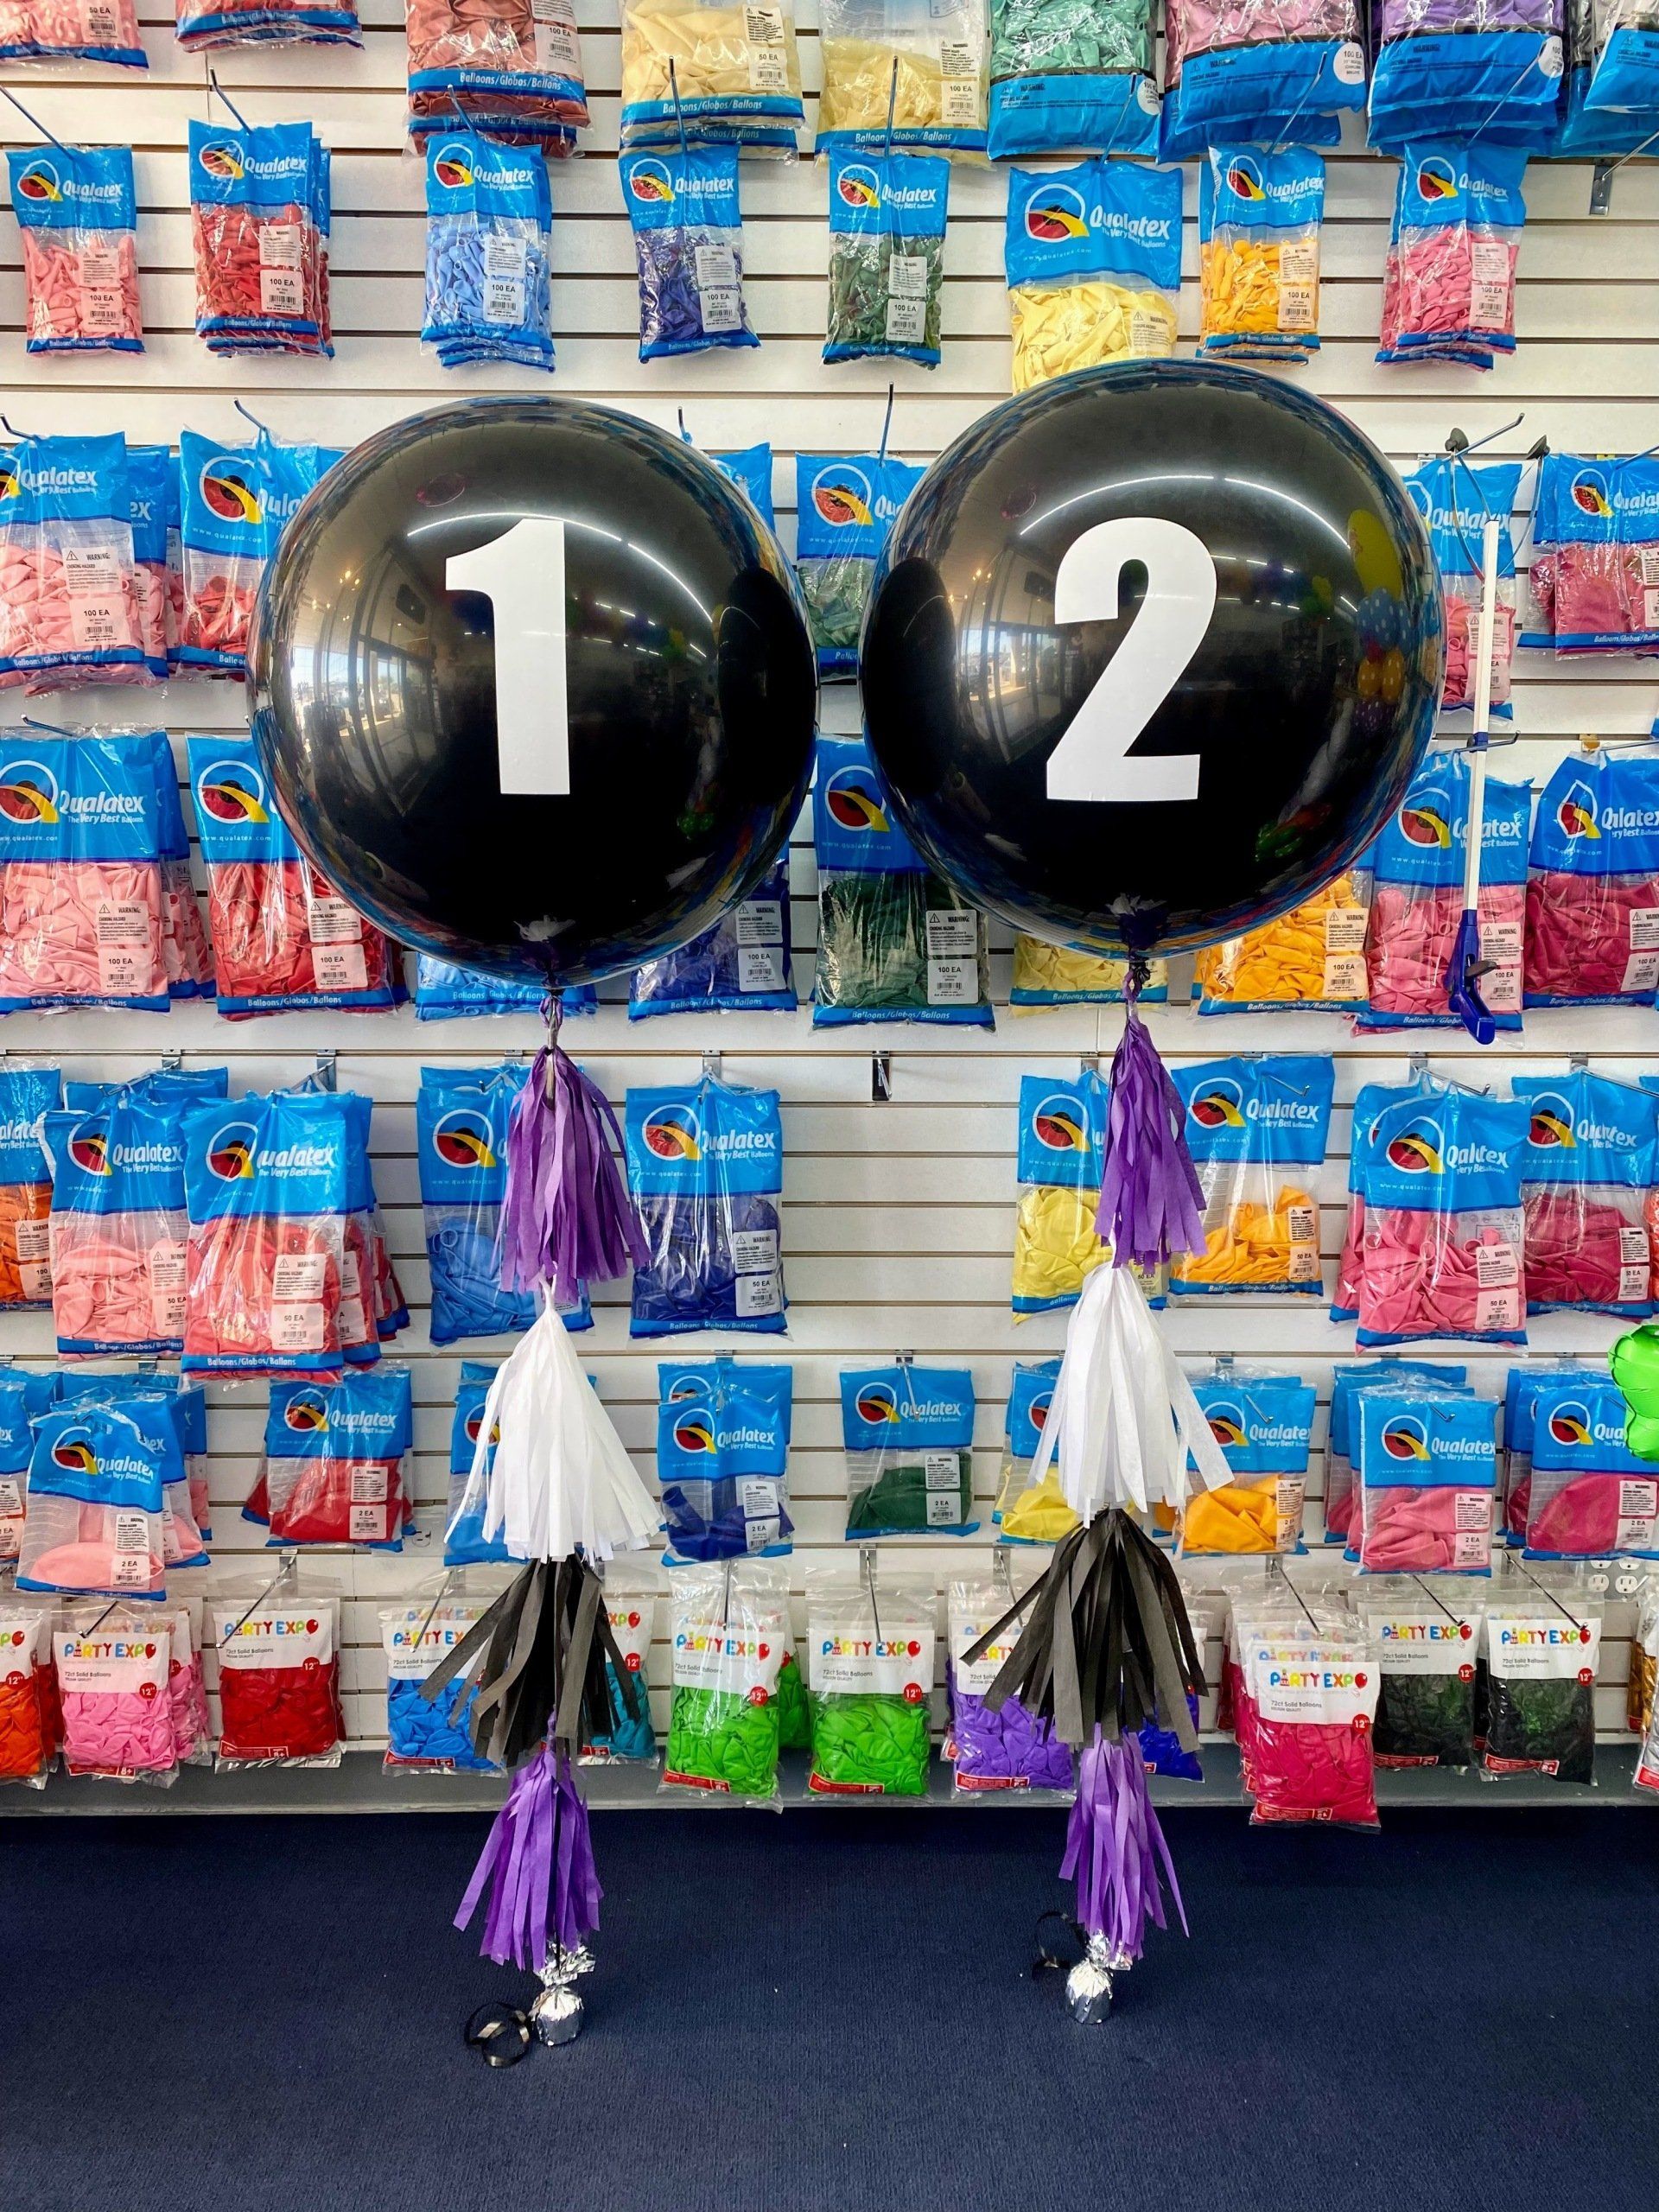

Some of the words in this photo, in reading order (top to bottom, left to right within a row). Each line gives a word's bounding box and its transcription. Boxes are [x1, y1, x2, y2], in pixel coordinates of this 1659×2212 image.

[549, 27, 560, 35] 100
[561, 29, 572, 37] EA
[759, 53, 767, 61] 50
[769, 53, 779, 61] EA
[1343, 50, 1354, 59] 100
[460, 73, 562, 91] Balloons/Globos/Ballons
[663, 99, 762, 112] Baloons/Globos/Ballons
[855, 130, 951, 143] Balloon/Globos/Ballons
[245, 156, 307, 173] Qualatex
[473, 166, 534, 184] Qualatex
[63, 181, 123, 198] Qualatex
[881, 184, 937, 203] Qualatex
[1266, 177, 1325, 198] Qualatex
[1090, 206, 1172, 238] Qualatex
[269, 278, 280, 287] 100
[1481, 285, 1492, 295] 100
[1493, 285, 1503, 294] EA
[20, 468, 99, 491] Qualatex
[445, 518, 570, 795] 1
[1046, 516, 1217, 802] 2
[59, 791, 145, 815] Qualatex
[79, 813, 99, 826] Very
[100, 814, 120, 823] Best
[1624, 829, 1639, 837] Best
[1332, 963, 1344, 971] 100
[1345, 963, 1356, 971] EA
[247, 996, 342, 1007] Balloons/Globos/Ballons
[1246, 1099, 1319, 1123] Qualatex
[699, 1130, 776, 1152] Qualatex
[112, 1143, 182, 1167] Qualatex
[732, 1149, 750, 1159] Best
[132, 1164, 149, 1175] Very
[270, 1167, 285, 1179] Very
[287, 1167, 307, 1176] Best
[207, 1357, 296, 1367] Balloons/Globos/Ballons
[329, 1410, 396, 1429] Qualatex
[717, 1429, 776, 1448] Qualatex
[1431, 1437, 1496, 1454] Qualatex
[444, 1631, 464, 1644] EX
